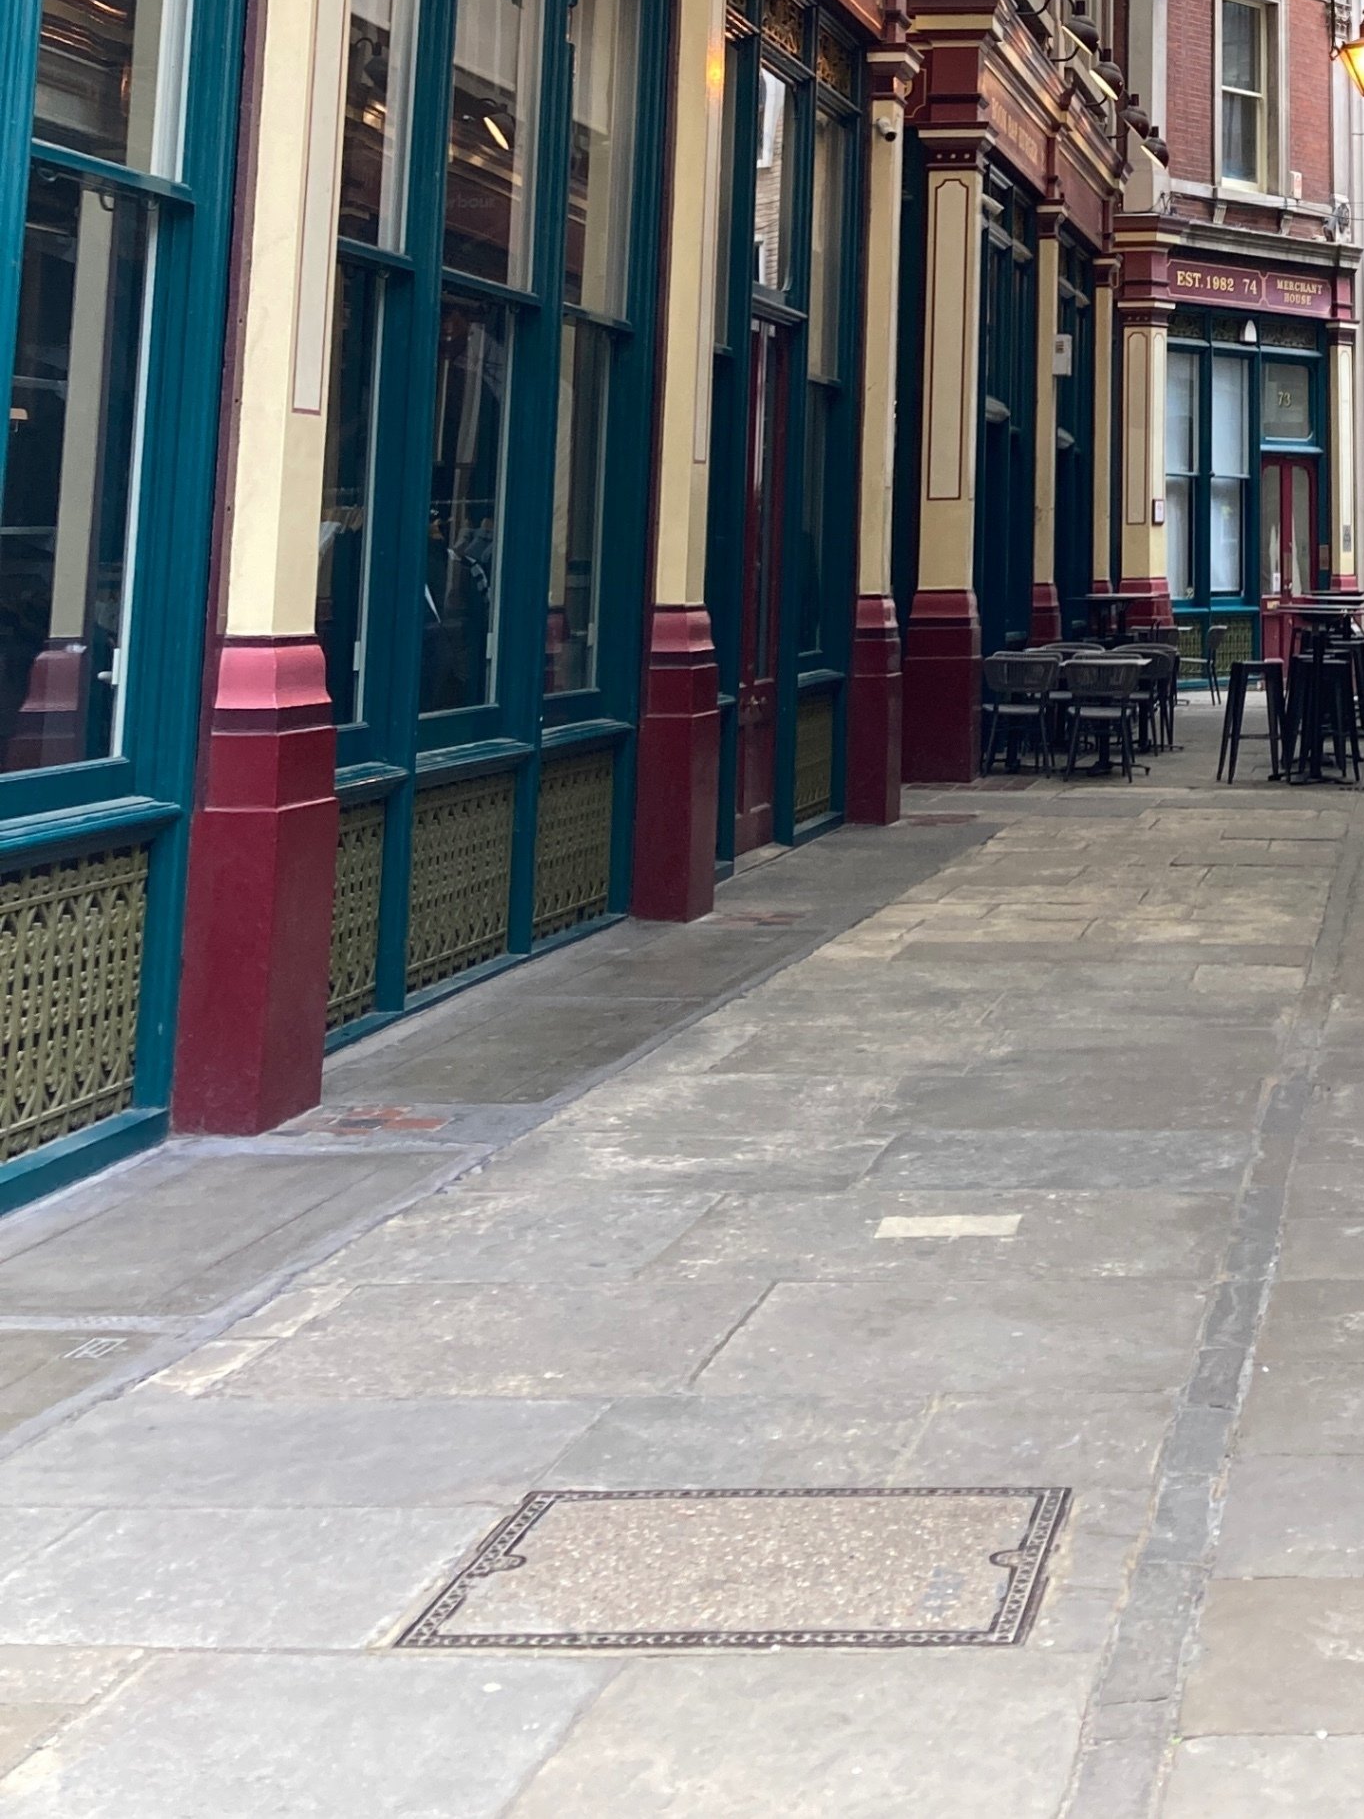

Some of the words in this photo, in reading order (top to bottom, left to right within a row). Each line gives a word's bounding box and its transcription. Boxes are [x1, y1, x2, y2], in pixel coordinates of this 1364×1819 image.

[1176, 270, 1204, 288] EST.
[1206, 275, 1235, 292] 1982
[1242, 278, 1258, 295] 74
[1276, 279, 1323, 295] MERCHANT
[1283, 292, 1312, 306] HOUSE
[1278, 390, 1292, 407] 73
